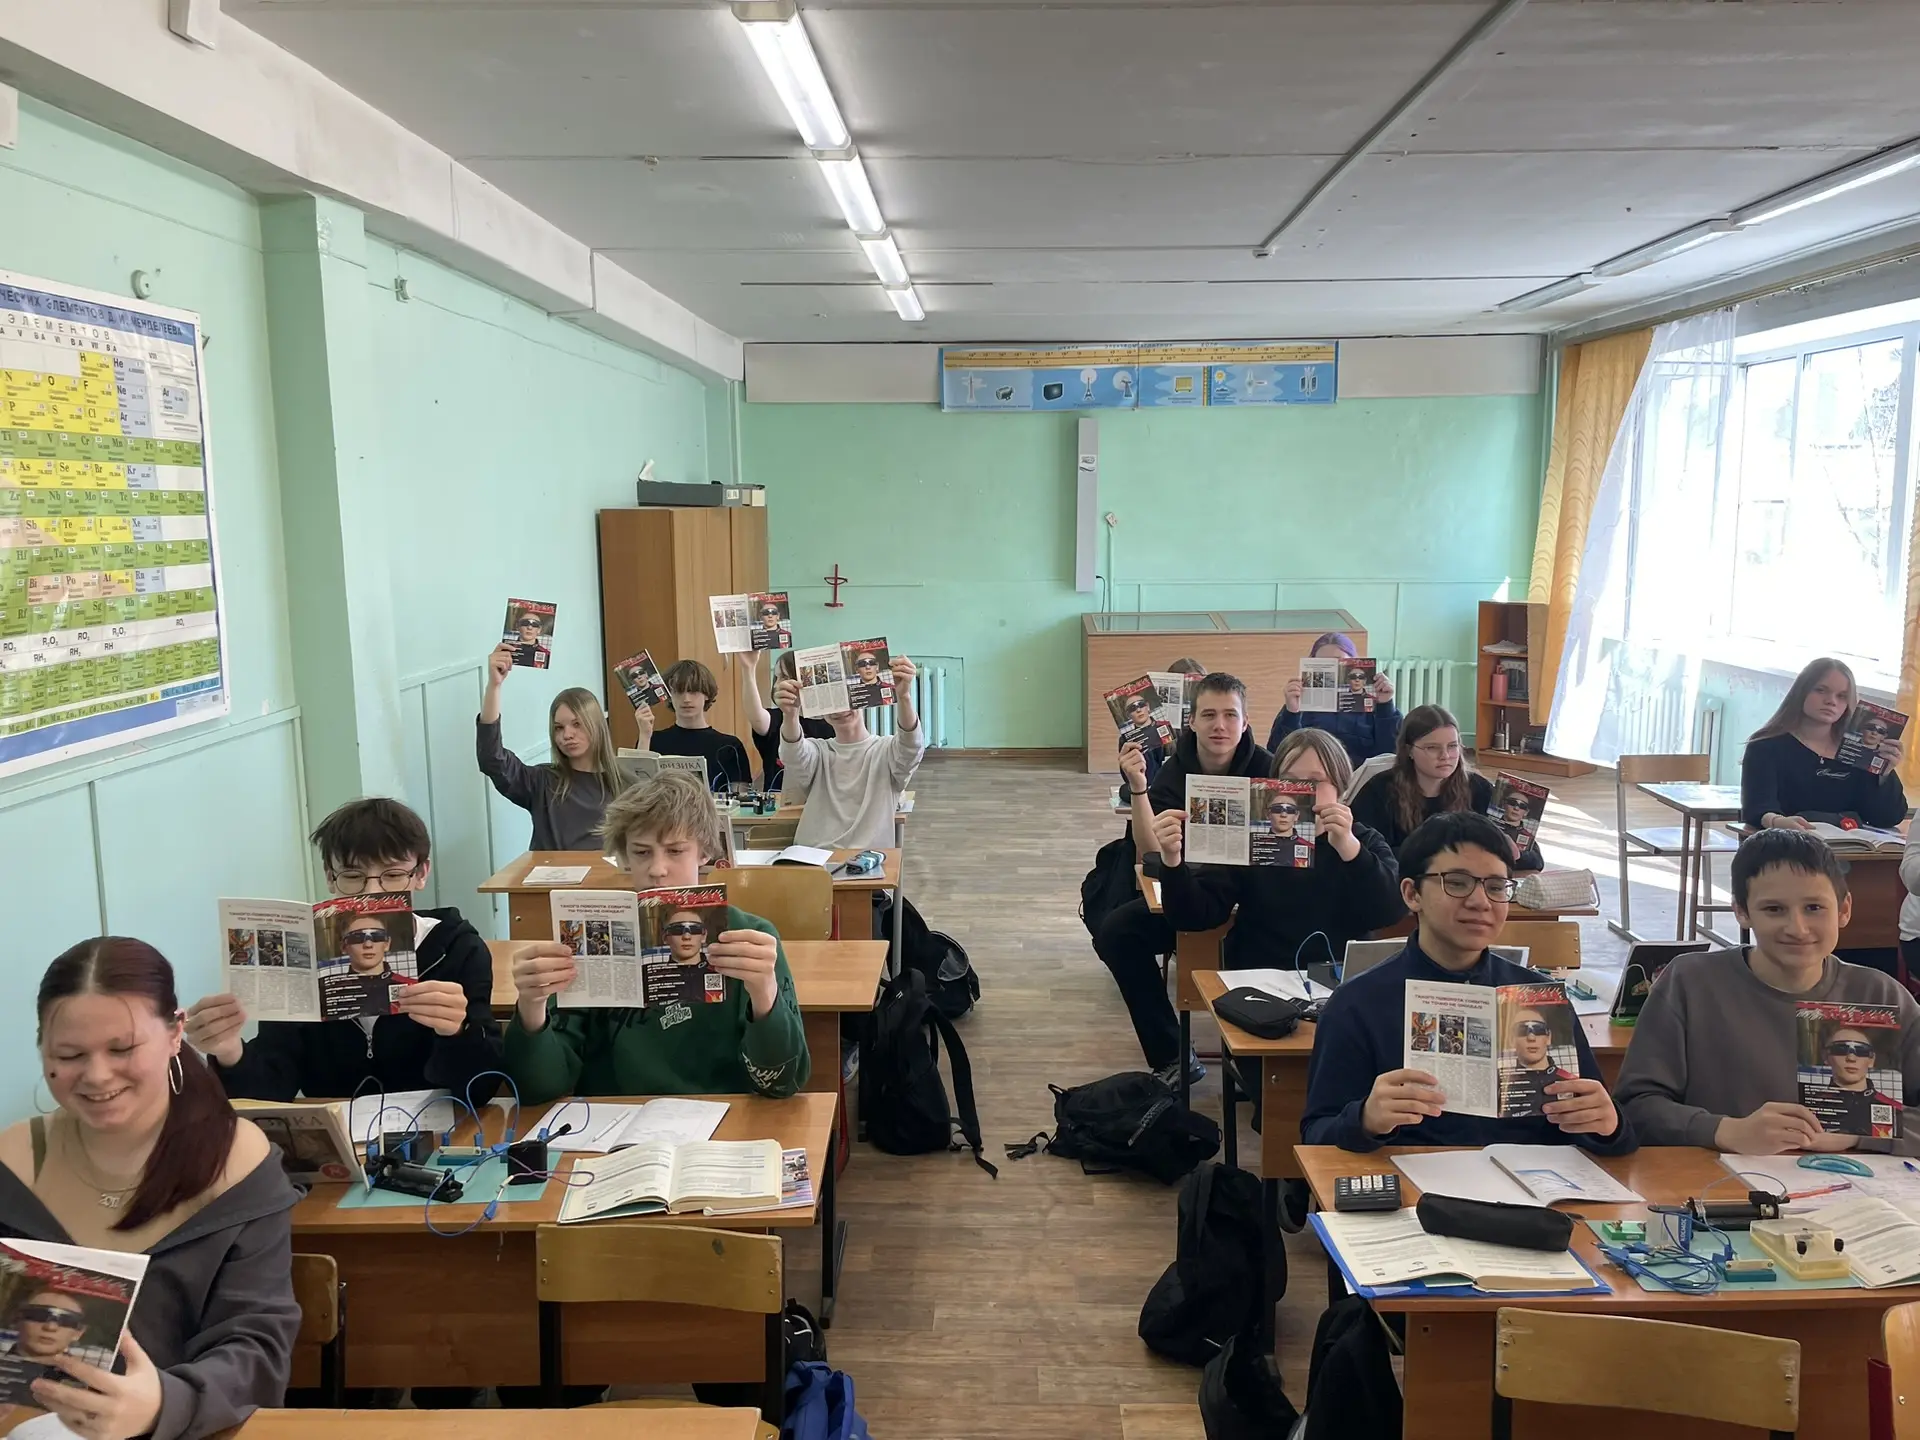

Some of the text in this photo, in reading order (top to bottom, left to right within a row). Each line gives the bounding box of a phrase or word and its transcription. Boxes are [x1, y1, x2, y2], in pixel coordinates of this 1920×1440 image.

[46, 298, 105, 319] ЭЛЕМЕНТОВ
[131, 315, 183, 336] МЕНДЕЛЕЕВА
[113, 358, 124, 368] He
[84, 380, 89, 390] F
[117, 385, 127, 395] Ne
[9, 401, 16, 411] P
[120, 412, 128, 421] Ar
[19, 461, 31, 471] As
[60, 462, 70, 472] Se
[94, 464, 102, 473] Br
[26, 519, 37, 530] Sb
[63, 519, 73, 529] Te
[29, 578, 37, 588] Bi
[66, 575, 76, 585] Po
[104, 642, 114, 650] RH
[660, 762, 701, 770] ФИЗИКА
